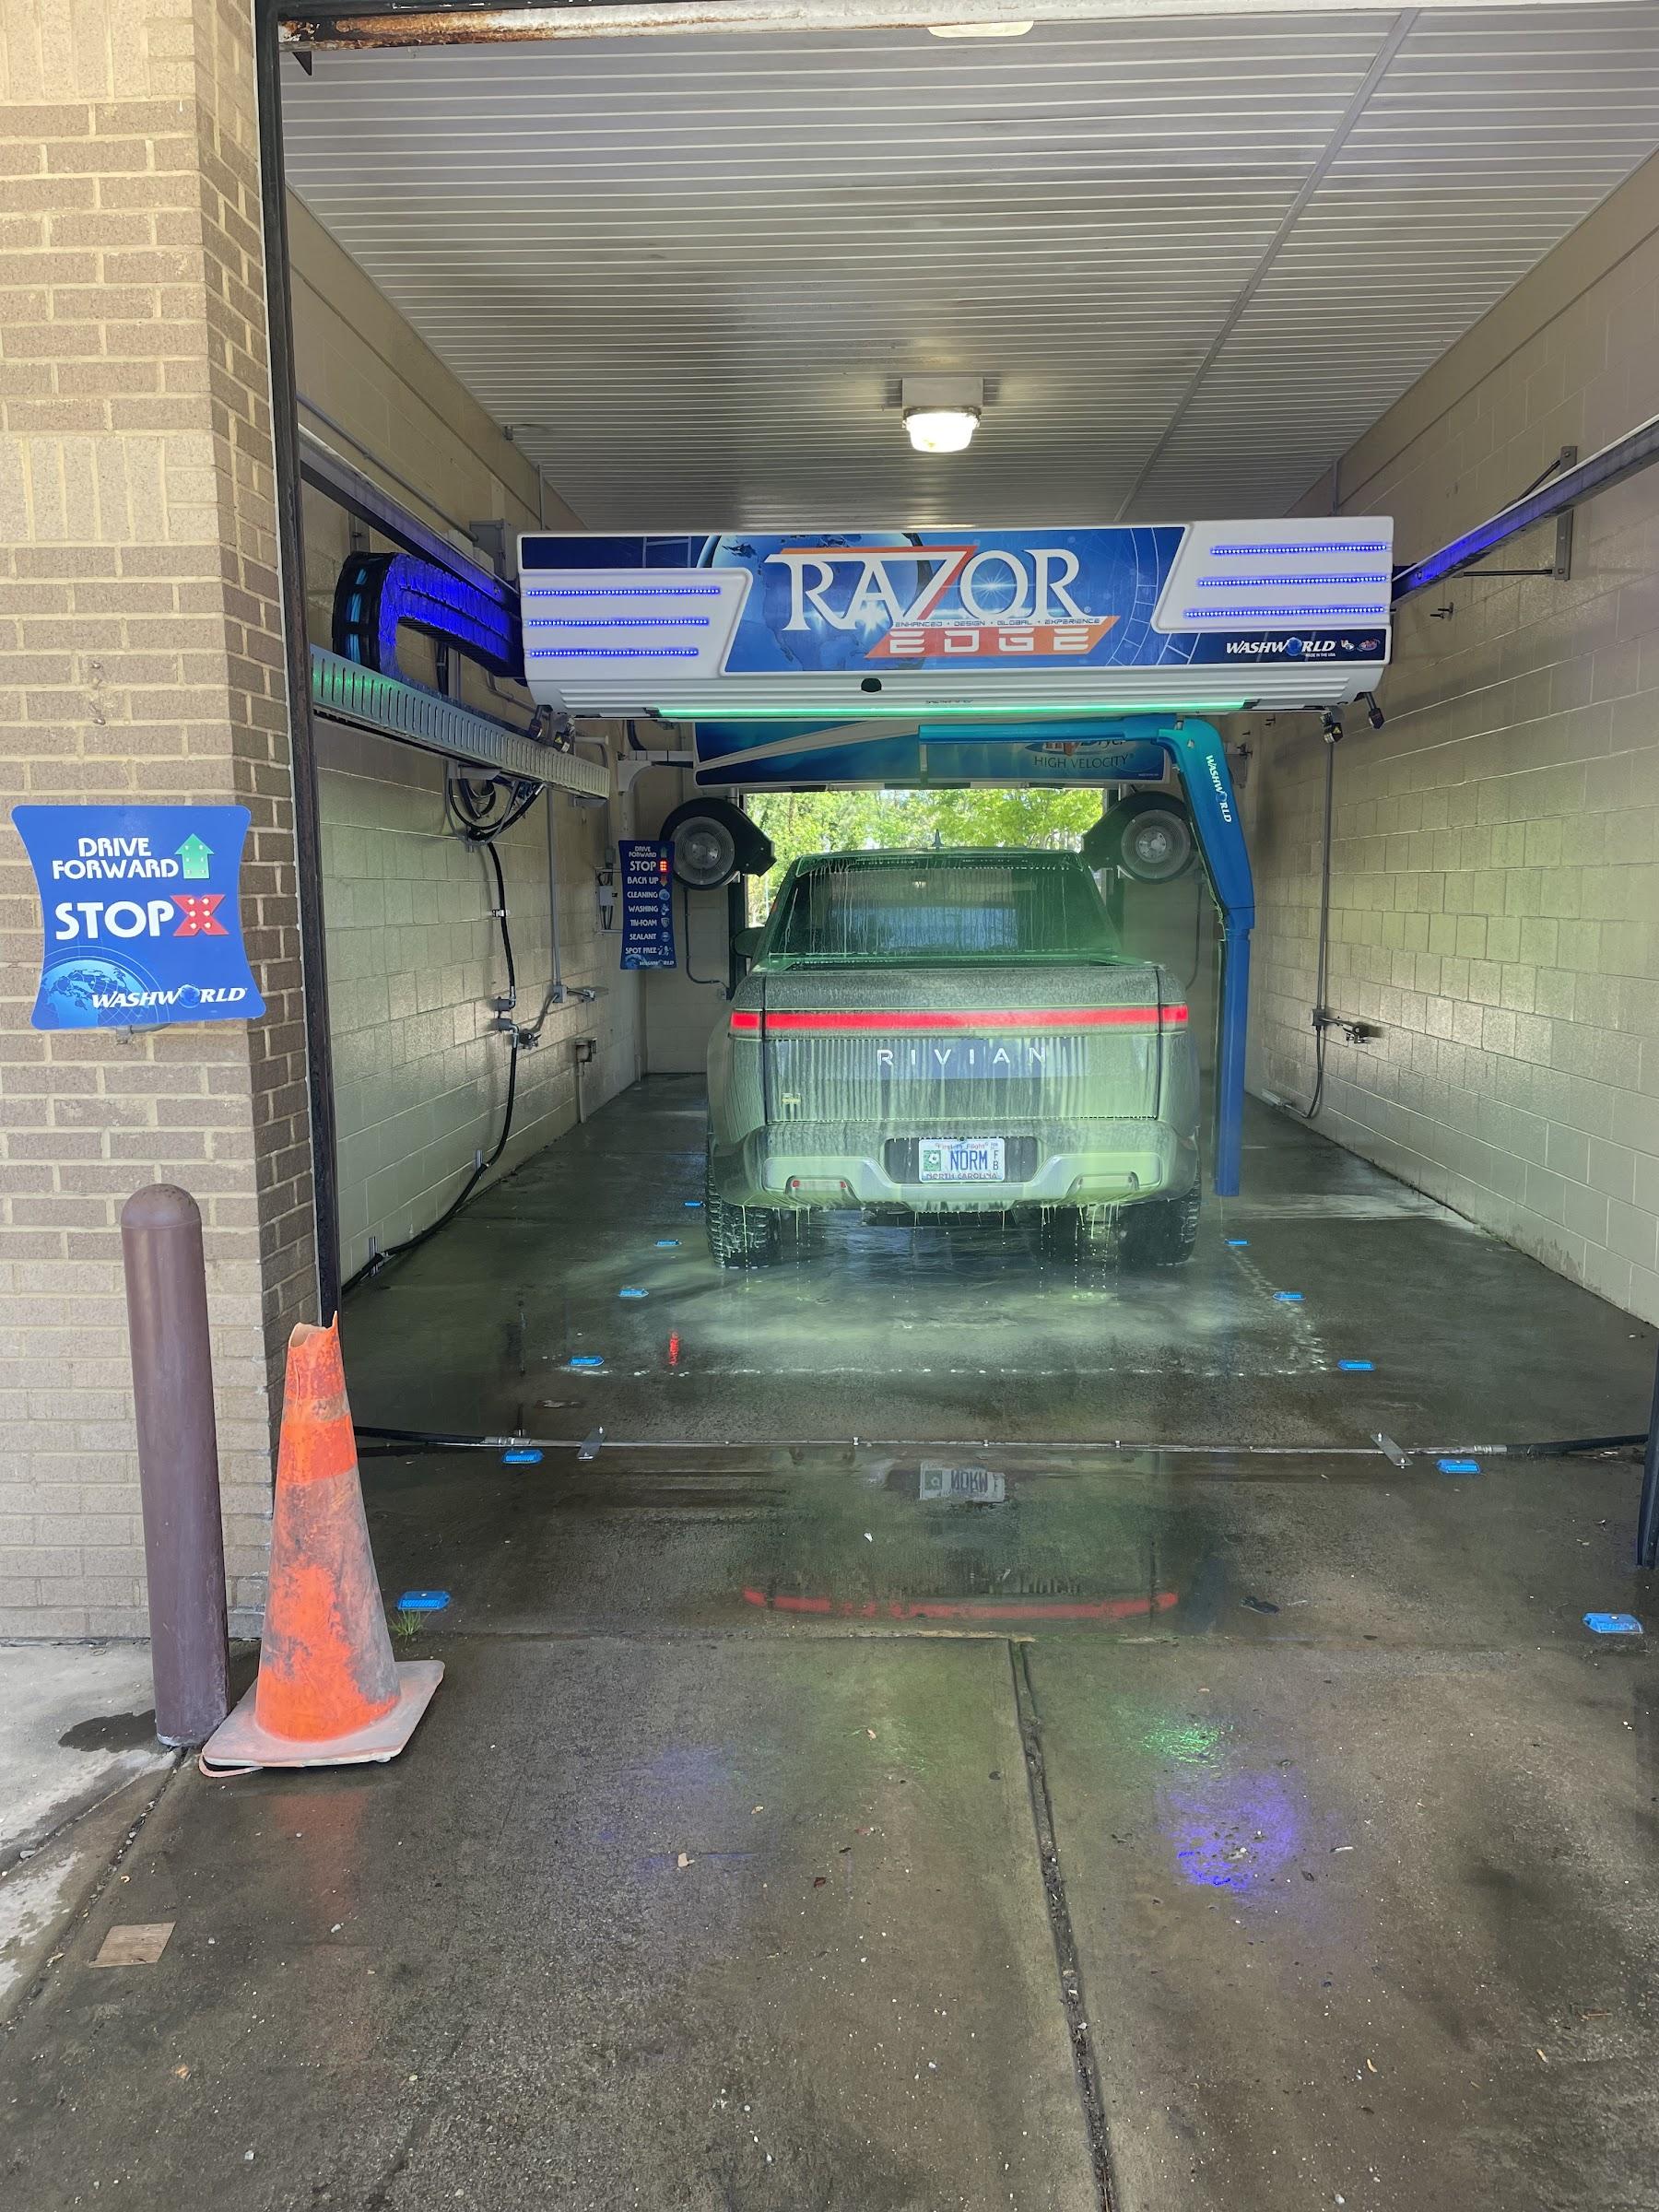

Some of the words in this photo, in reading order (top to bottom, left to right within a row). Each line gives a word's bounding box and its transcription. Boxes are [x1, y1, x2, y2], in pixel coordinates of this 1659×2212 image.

[764, 548, 1100, 631] RAZOR
[889, 627, 1089, 653] EDGE
[1033, 756, 1066, 769] HIGH
[1071, 754, 1129, 769] VELOCITY
[77, 837, 152, 857] DRIVE
[52, 859, 180, 880] FORWARD
[629, 860, 657, 872] STOP
[627, 877, 648, 885] BACK
[648, 877, 659, 885] UP
[627, 890, 658, 899] CLEANING
[628, 905, 659, 913] WASHING
[54, 900, 175, 941] STOP
[629, 933, 657, 941] SEALANT
[625, 947, 642, 955] SPOT
[642, 947, 657, 955] FREE
[877, 1046, 1047, 1065] RIVIAN
[950, 1150, 988, 1171] NORM
